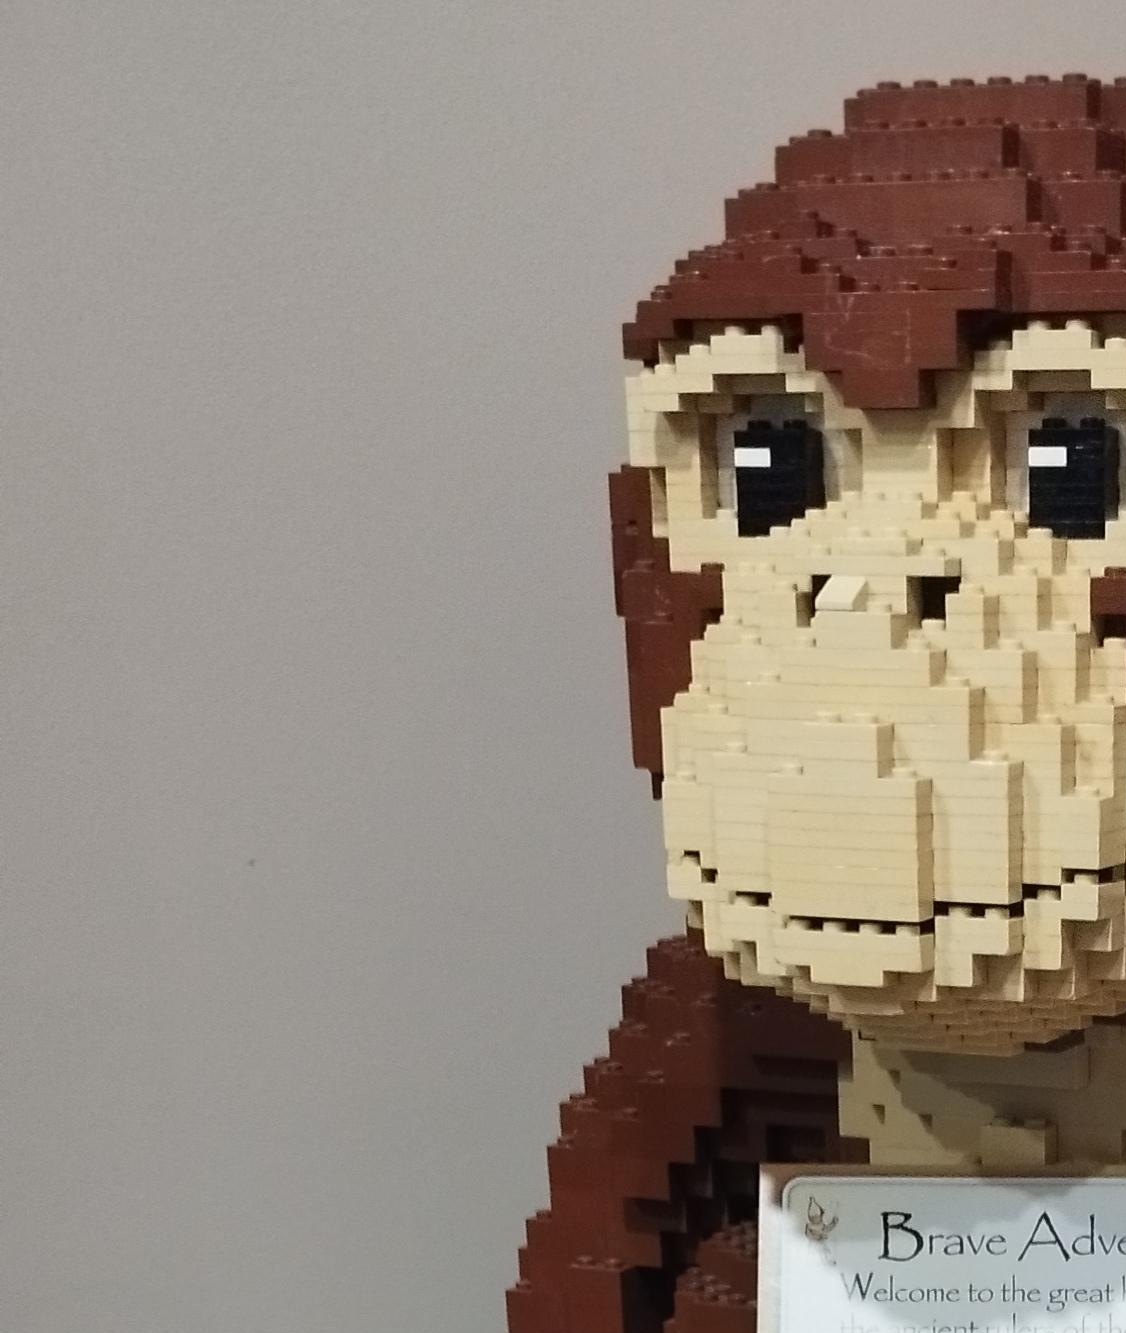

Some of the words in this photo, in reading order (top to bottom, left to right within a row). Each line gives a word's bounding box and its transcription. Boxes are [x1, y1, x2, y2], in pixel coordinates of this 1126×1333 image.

[877, 1211, 1007, 1261] Brave
[841, 1272, 962, 1304] Welcome
[968, 1283, 994, 1304] to
[1001, 1274, 1042, 1303] the
[1047, 1283, 1114, 1312] great
